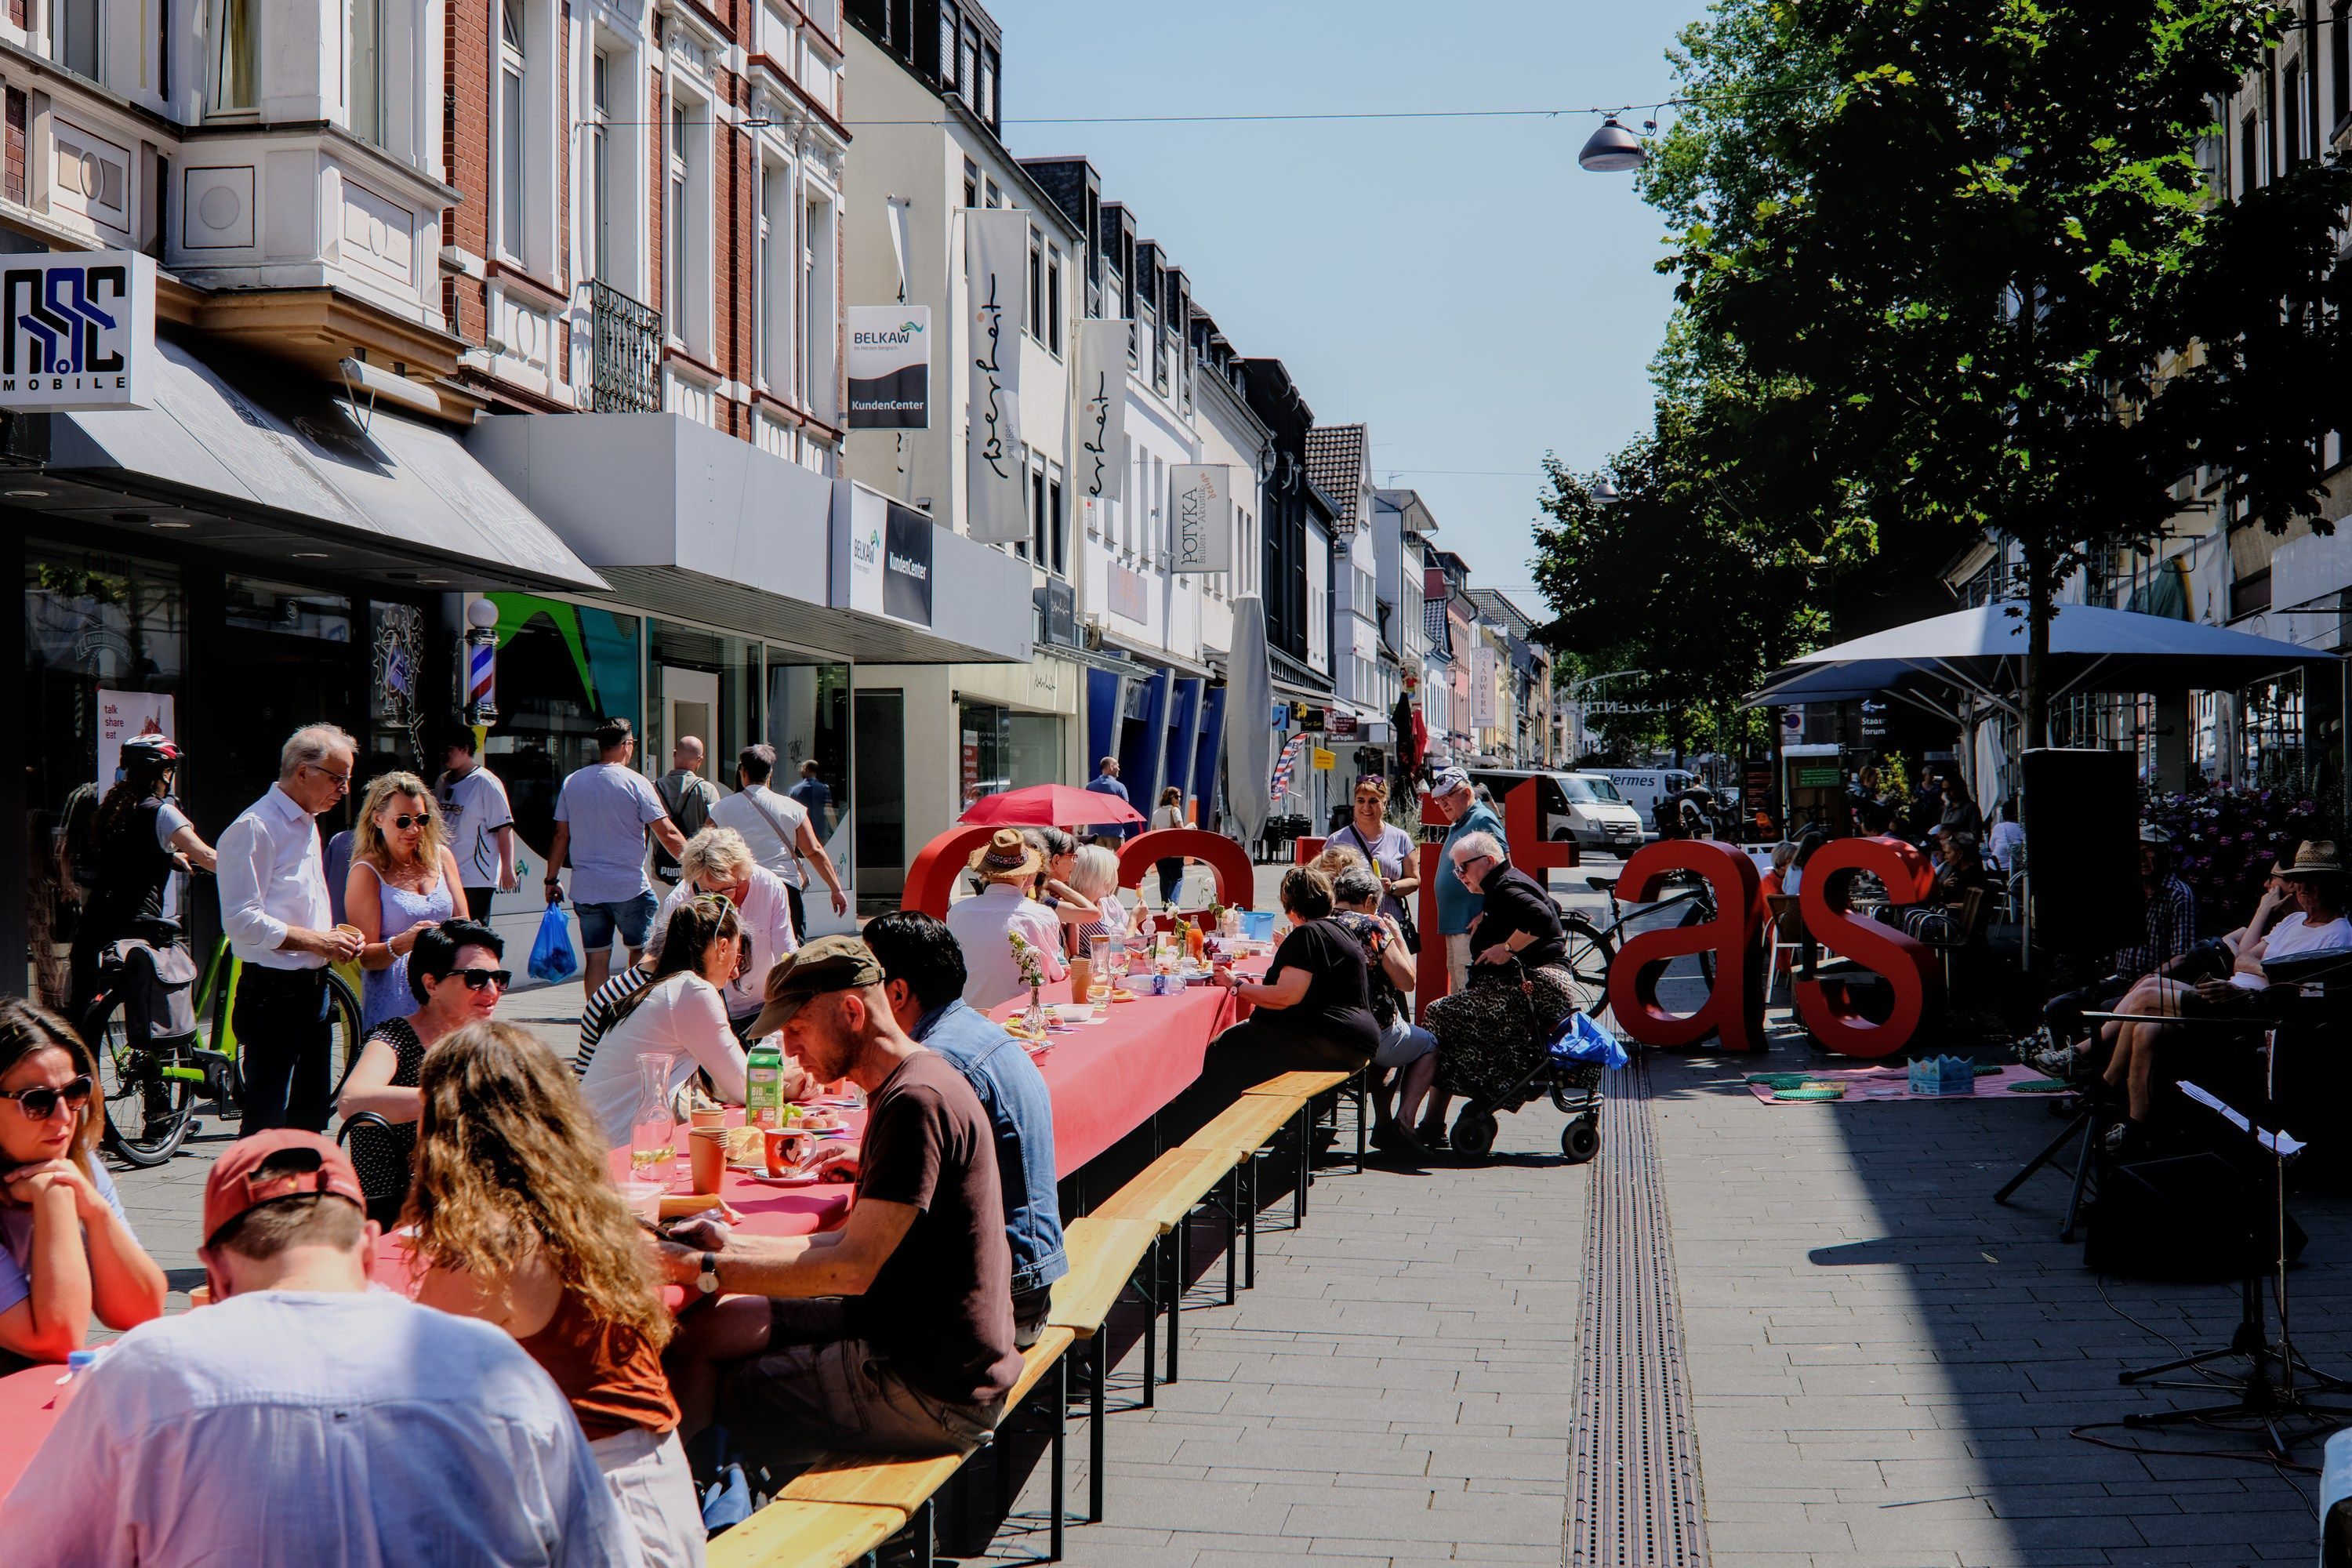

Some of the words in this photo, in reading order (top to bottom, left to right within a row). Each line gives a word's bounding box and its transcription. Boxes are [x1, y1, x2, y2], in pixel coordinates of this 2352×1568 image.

[854, 332, 909, 344] BELKAW
[3, 376, 125, 391] MOBILE
[852, 400, 924, 410] KundenCenter
[1182, 487, 1197, 564] POTYKA
[854, 539, 875, 564] BELKAW
[889, 551, 927, 580] KundenCenter
[1479, 660, 1487, 715] RADWERK
[104, 704, 118, 714] talk
[105, 716, 124, 728] share
[105, 731, 117, 739] eat
[1861, 727, 1886, 735] forum
[660, 866, 681, 877] PUM
[751, 1087, 763, 1096] BIO
